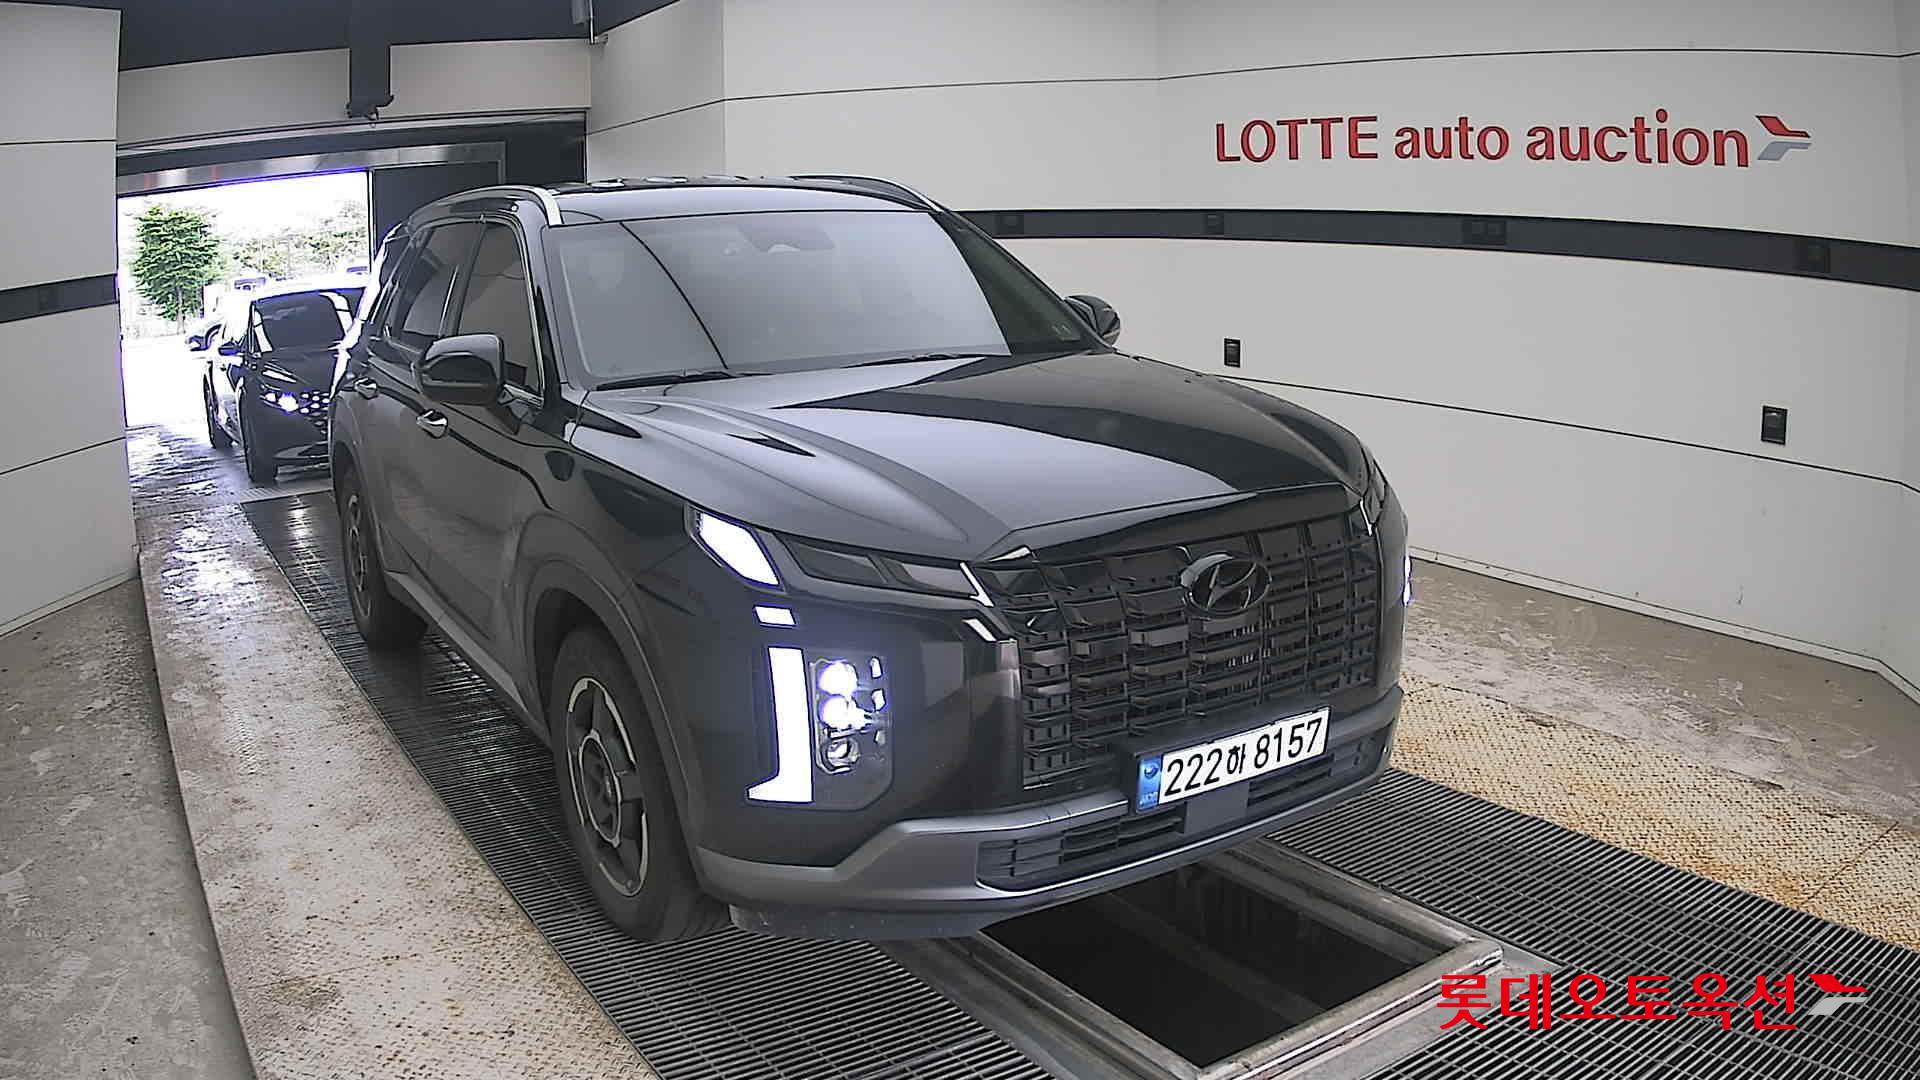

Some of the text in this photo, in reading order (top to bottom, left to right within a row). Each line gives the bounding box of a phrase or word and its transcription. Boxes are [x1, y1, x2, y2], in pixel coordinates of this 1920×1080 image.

[1215, 108, 1750, 168] LOTTE auto auction
[1164, 717, 1323, 797] 222하 8157
